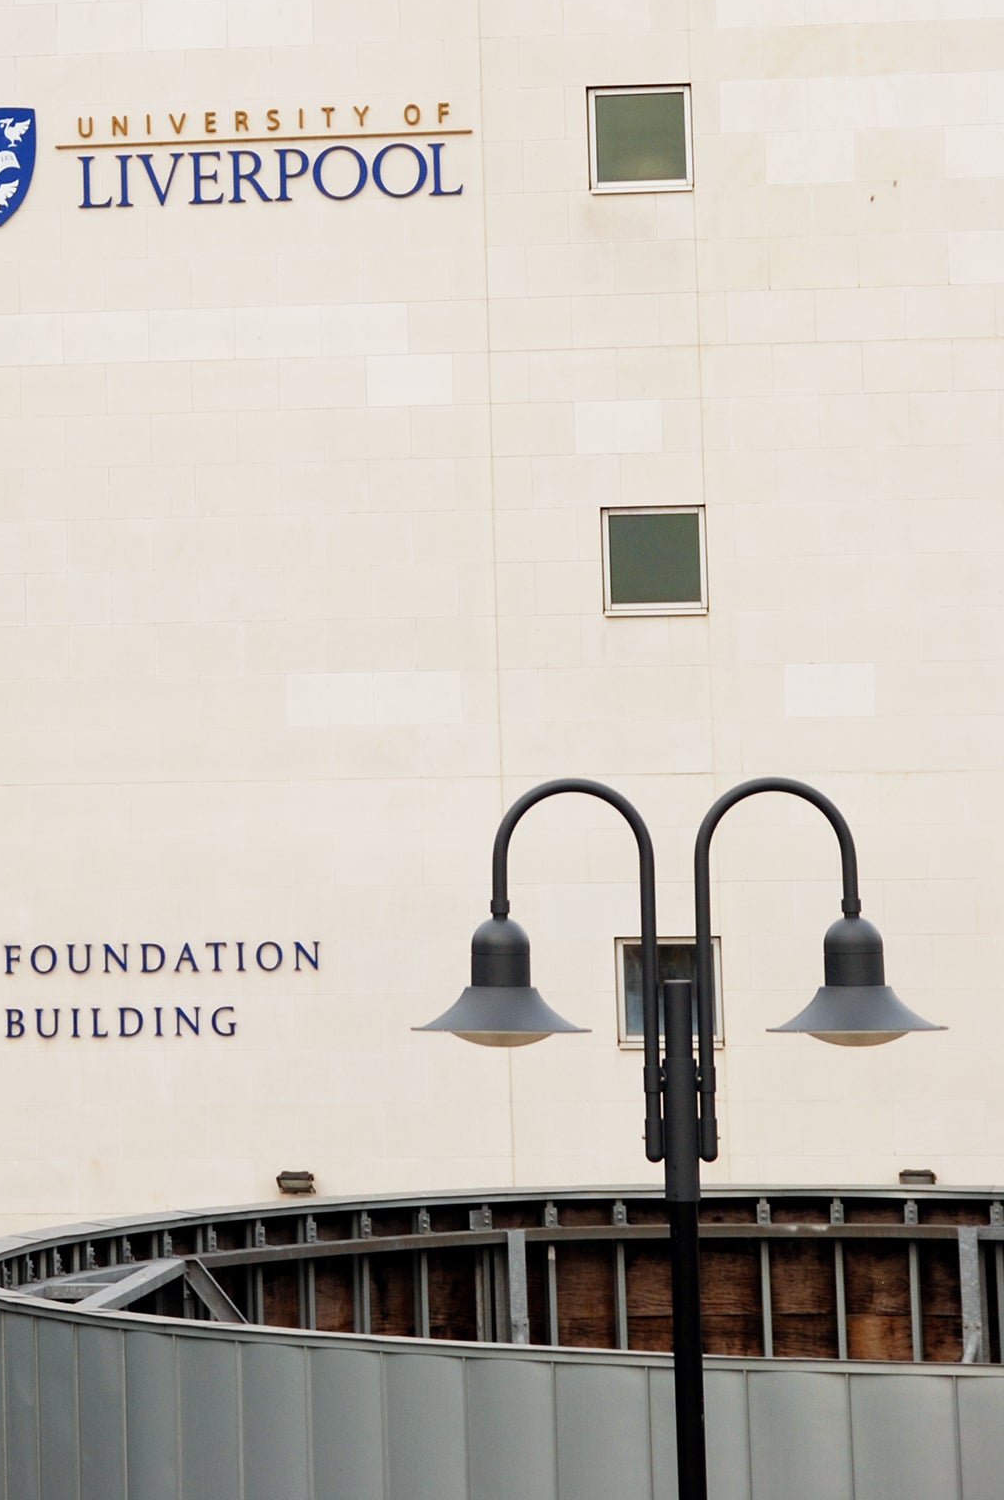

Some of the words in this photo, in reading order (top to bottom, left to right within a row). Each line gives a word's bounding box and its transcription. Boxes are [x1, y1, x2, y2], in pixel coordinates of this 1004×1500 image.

[77, 105, 370, 140] UNIVERSITY
[403, 102, 450, 127] OF
[77, 142, 464, 209] LIVERPOOL
[4, 941, 321, 975] FOUNDATION
[5, 1006, 237, 1039] BUILDING
